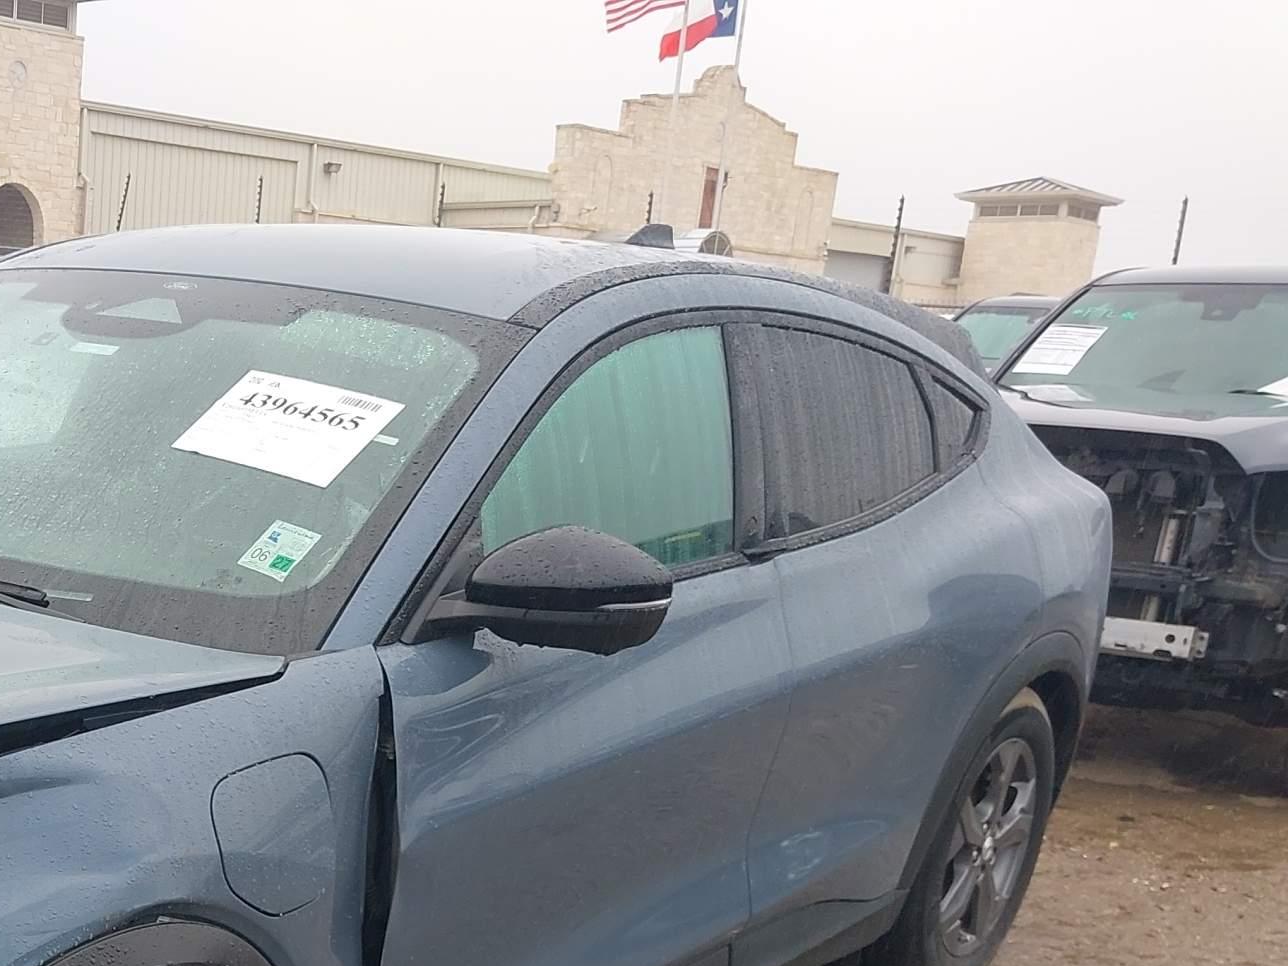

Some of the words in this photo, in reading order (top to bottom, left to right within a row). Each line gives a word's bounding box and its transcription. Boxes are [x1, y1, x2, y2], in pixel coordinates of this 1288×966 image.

[239, 391, 367, 431] 43964565
[250, 547, 271, 562] 06
[271, 555, 292, 572] 27
